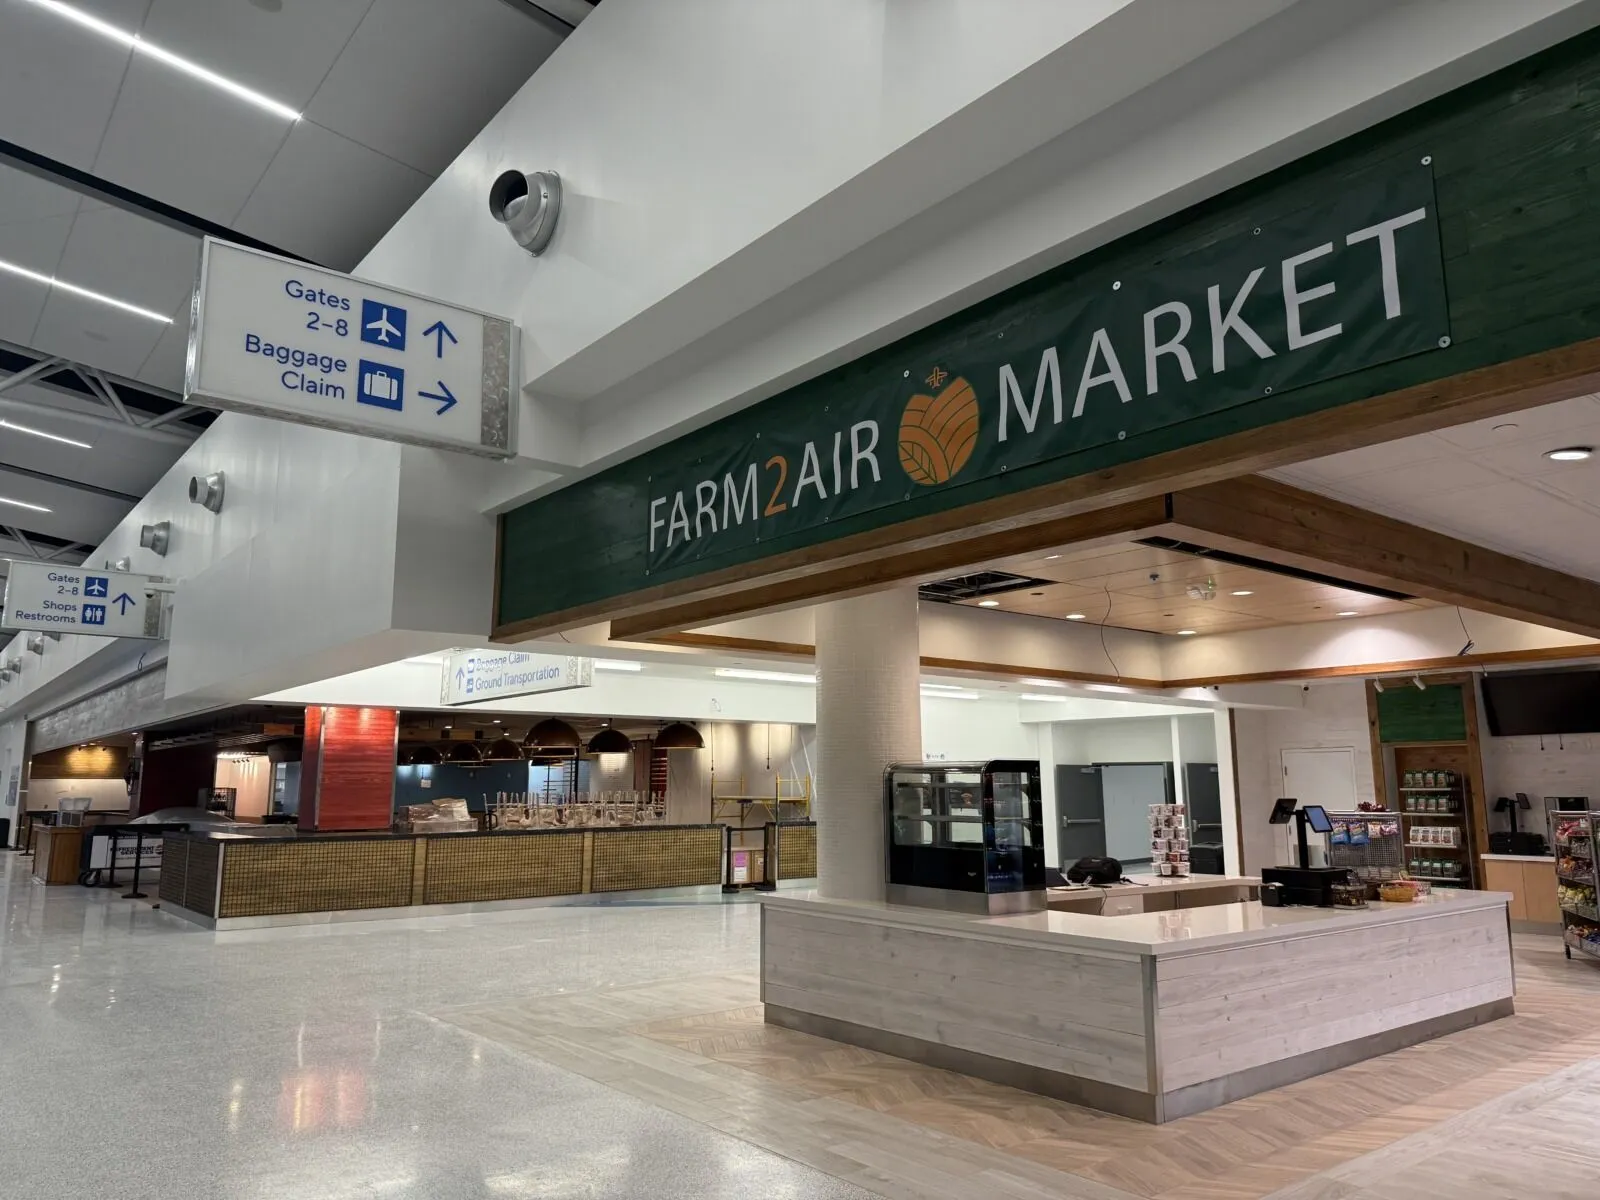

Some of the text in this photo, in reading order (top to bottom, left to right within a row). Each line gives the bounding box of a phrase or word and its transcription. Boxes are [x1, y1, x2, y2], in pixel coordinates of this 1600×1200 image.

[285, 279, 350, 311] Gates
[245, 333, 347, 373] Baggage
[281, 371, 345, 400] Claim
[649, 206, 1426, 553] FARM2AIR MARKET
[47, 572, 80, 584] Gates
[15, 610, 76, 624] Restrooms
[43, 600, 77, 612] Shops
[476, 656, 507, 673] Baggage
[475, 665, 560, 691] Ground Transportation
